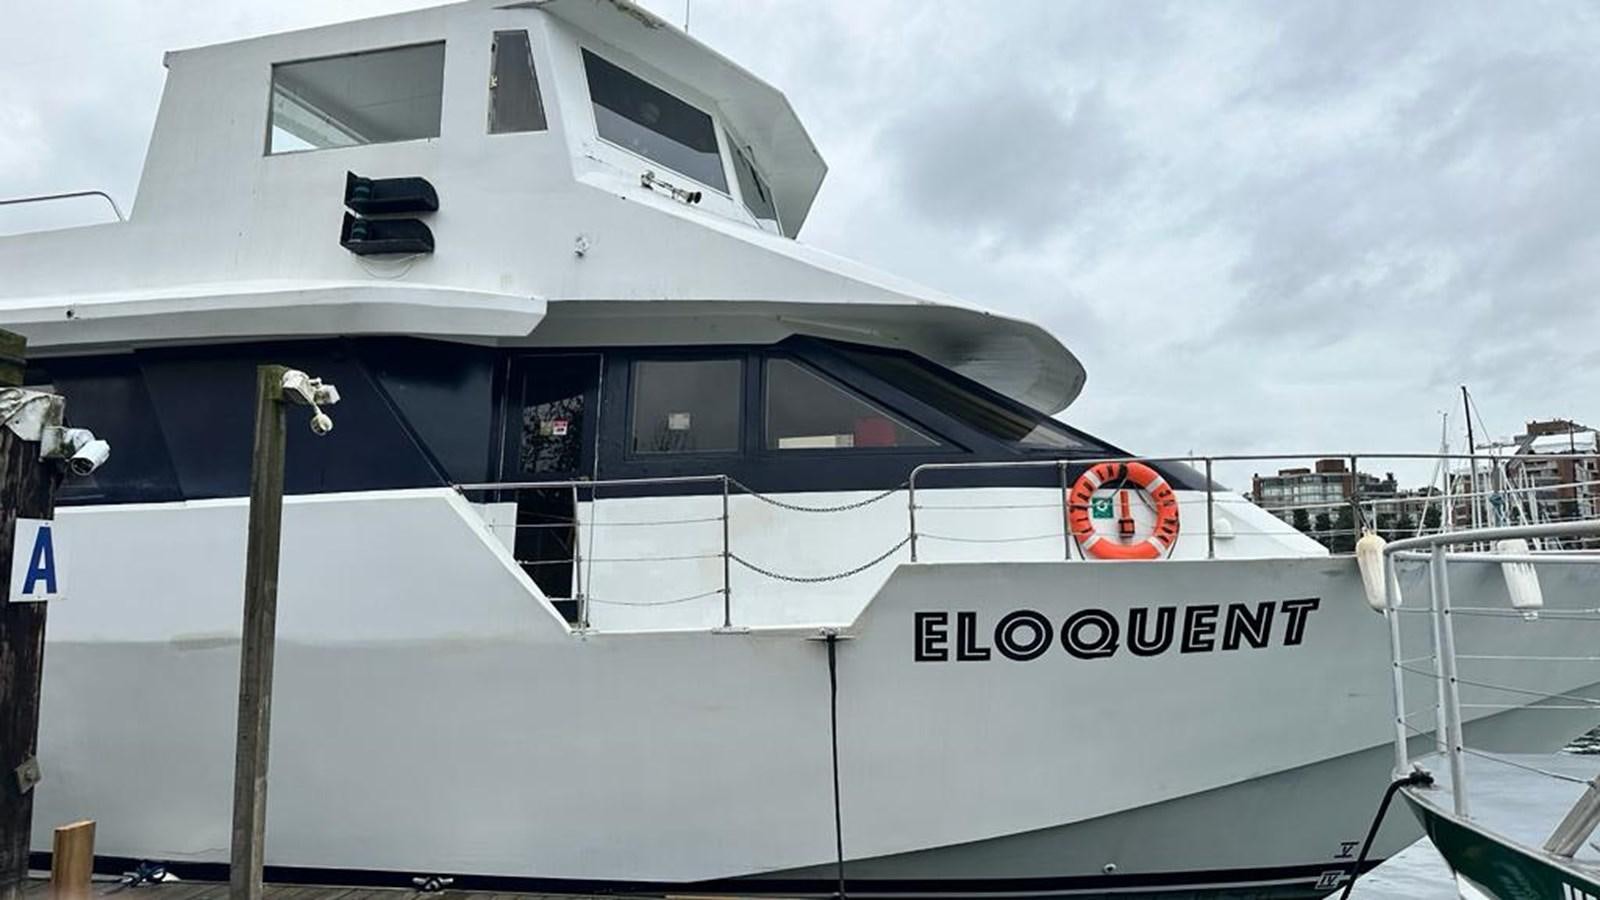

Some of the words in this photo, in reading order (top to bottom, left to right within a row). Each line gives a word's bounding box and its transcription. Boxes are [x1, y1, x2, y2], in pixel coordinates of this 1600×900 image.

[22, 526, 58, 594] A
[914, 597, 1321, 662] ELOQUENT
[1334, 841, 1360, 858] V
